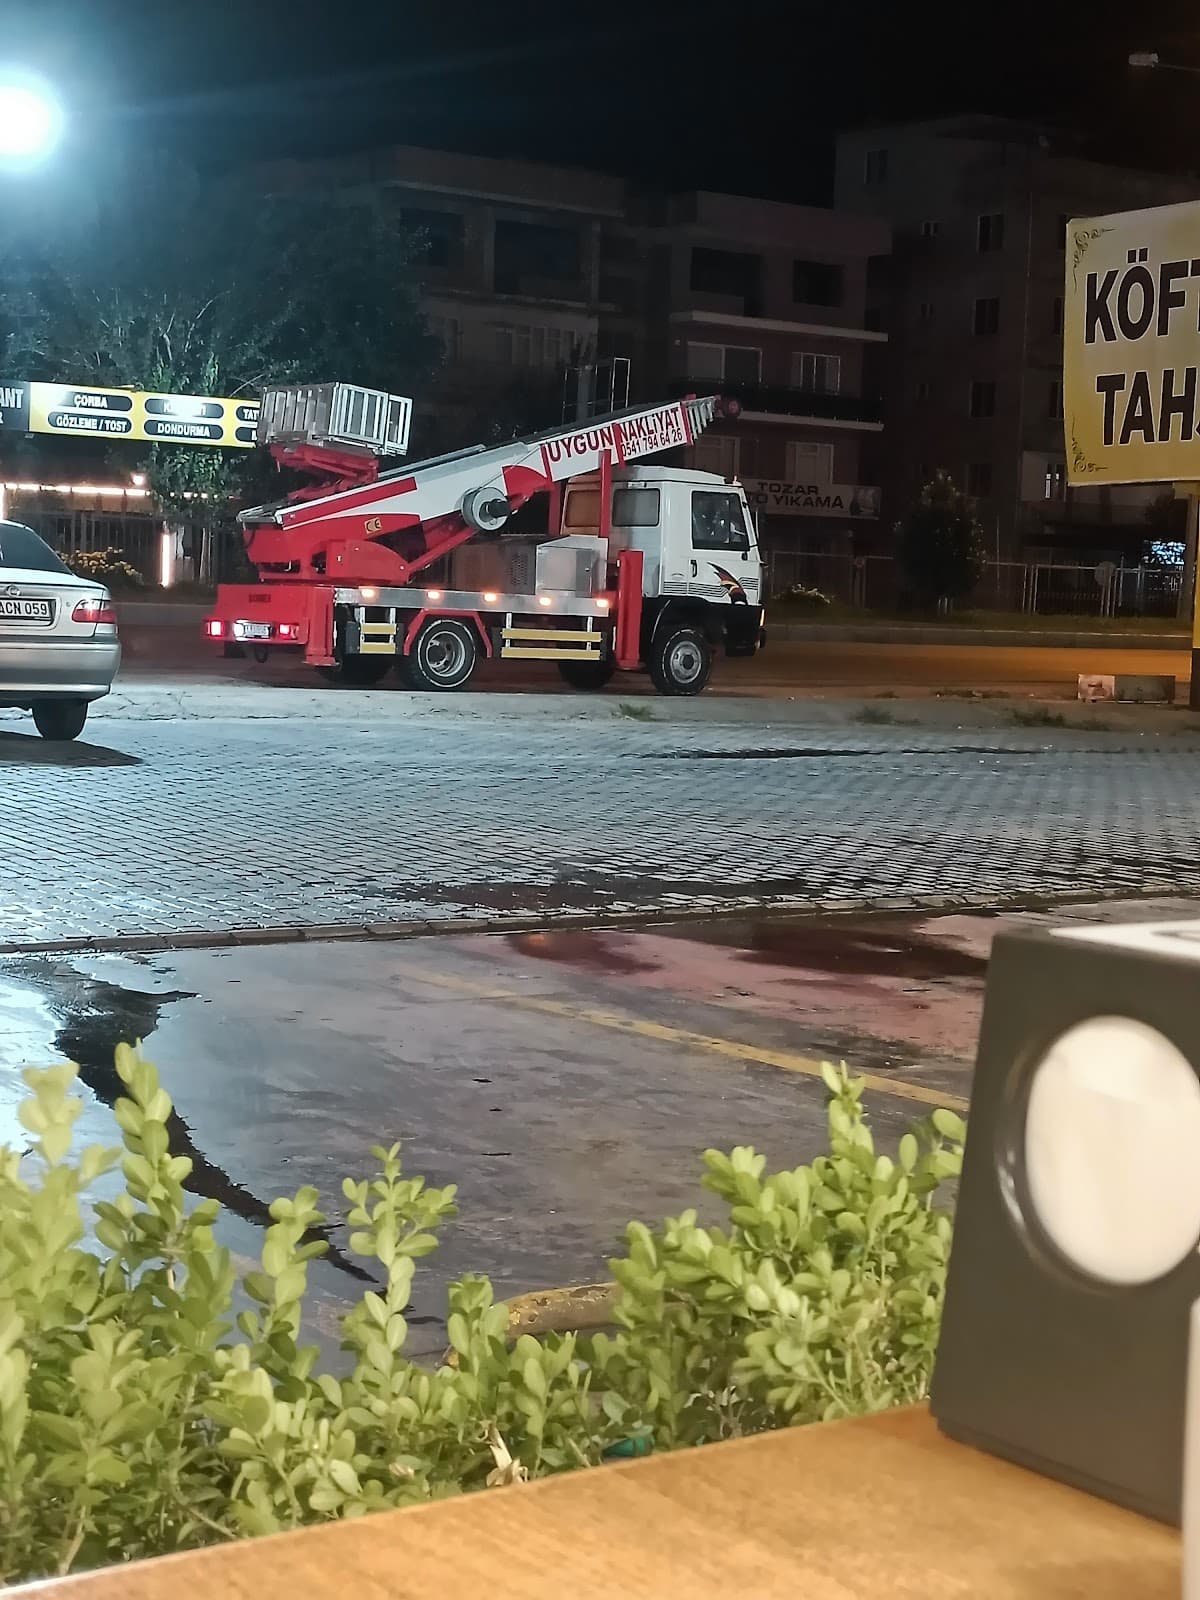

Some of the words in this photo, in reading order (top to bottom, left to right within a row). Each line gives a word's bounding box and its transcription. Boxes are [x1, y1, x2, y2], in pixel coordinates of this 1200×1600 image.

[74, 394, 108, 408] ÇORBA
[1096, 367, 1200, 446] TAH
[56, 413, 98, 430] GÖZLEME
[104, 420, 127, 432] TOST
[157, 422, 211, 437] DONDURMA
[548, 426, 613, 462] UYGUN
[622, 441, 641, 457] 0541
[643, 433, 659, 451] 794
[660, 429, 671, 446] 64
[672, 427, 683, 441] 26
[757, 482, 819, 495] TOZAR
[772, 494, 844, 509] YIKAMA
[25, 602, 47, 615] 059
